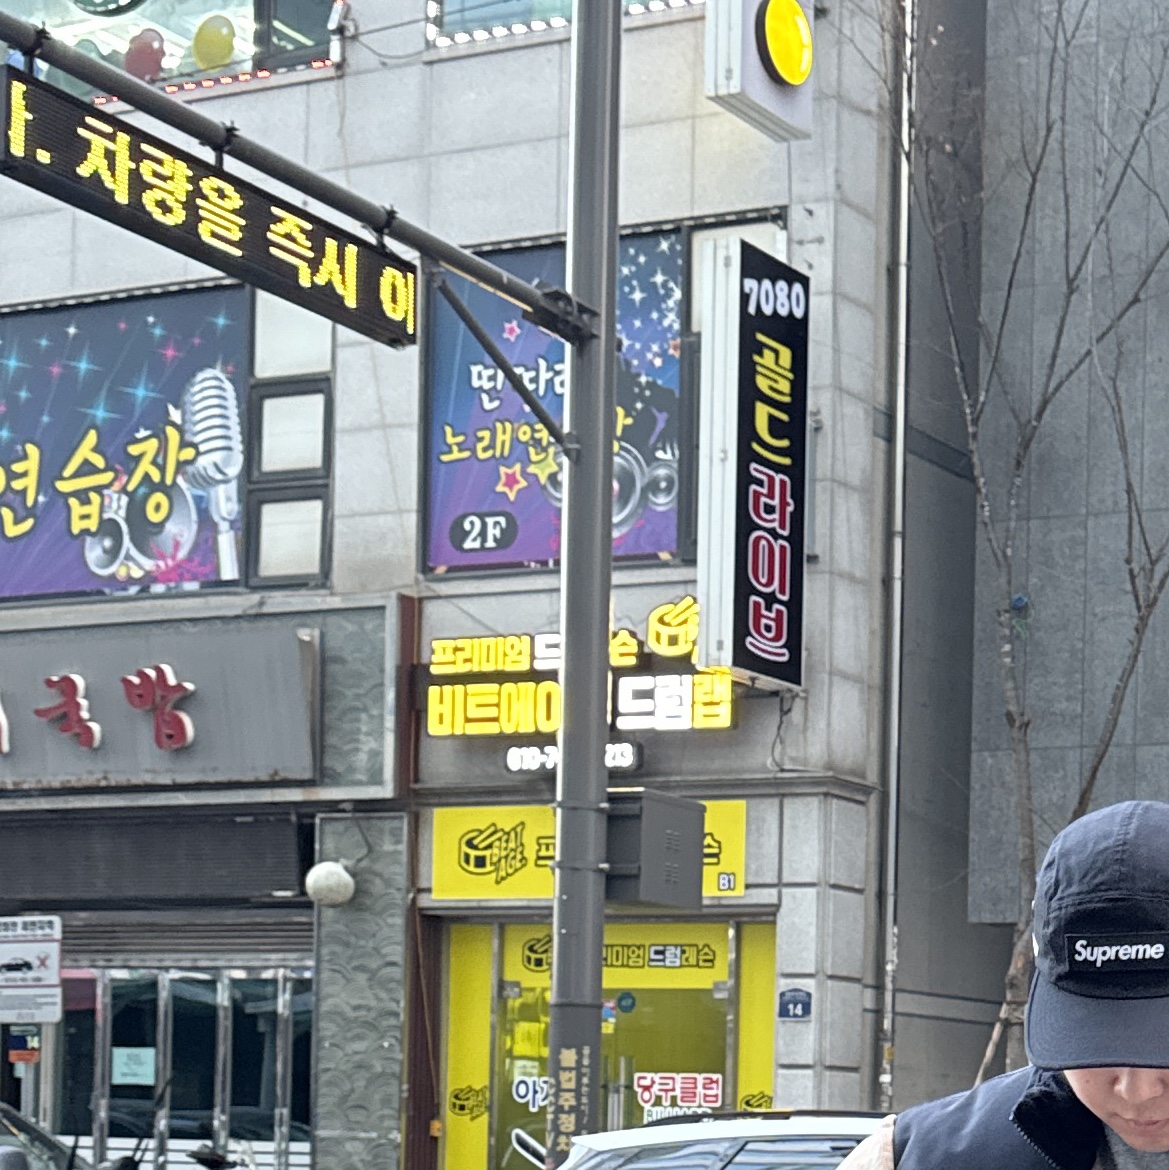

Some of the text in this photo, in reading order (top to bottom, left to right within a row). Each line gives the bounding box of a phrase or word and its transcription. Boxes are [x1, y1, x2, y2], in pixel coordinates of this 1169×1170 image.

[76, 115, 247, 257] 차량을
[266, 205, 358, 310] 즉시
[743, 277, 806, 320] 7080
[461, 516, 507, 550] 2F
[429, 634, 531, 675] 프리미엄
[718, 872, 736, 891] B1
[648, 944, 716, 968] 드럼레슨
[1073, 939, 1166, 968] Supreme
[787, 1003, 804, 1016] 14
[635, 1073, 722, 1107] 당구클럽
